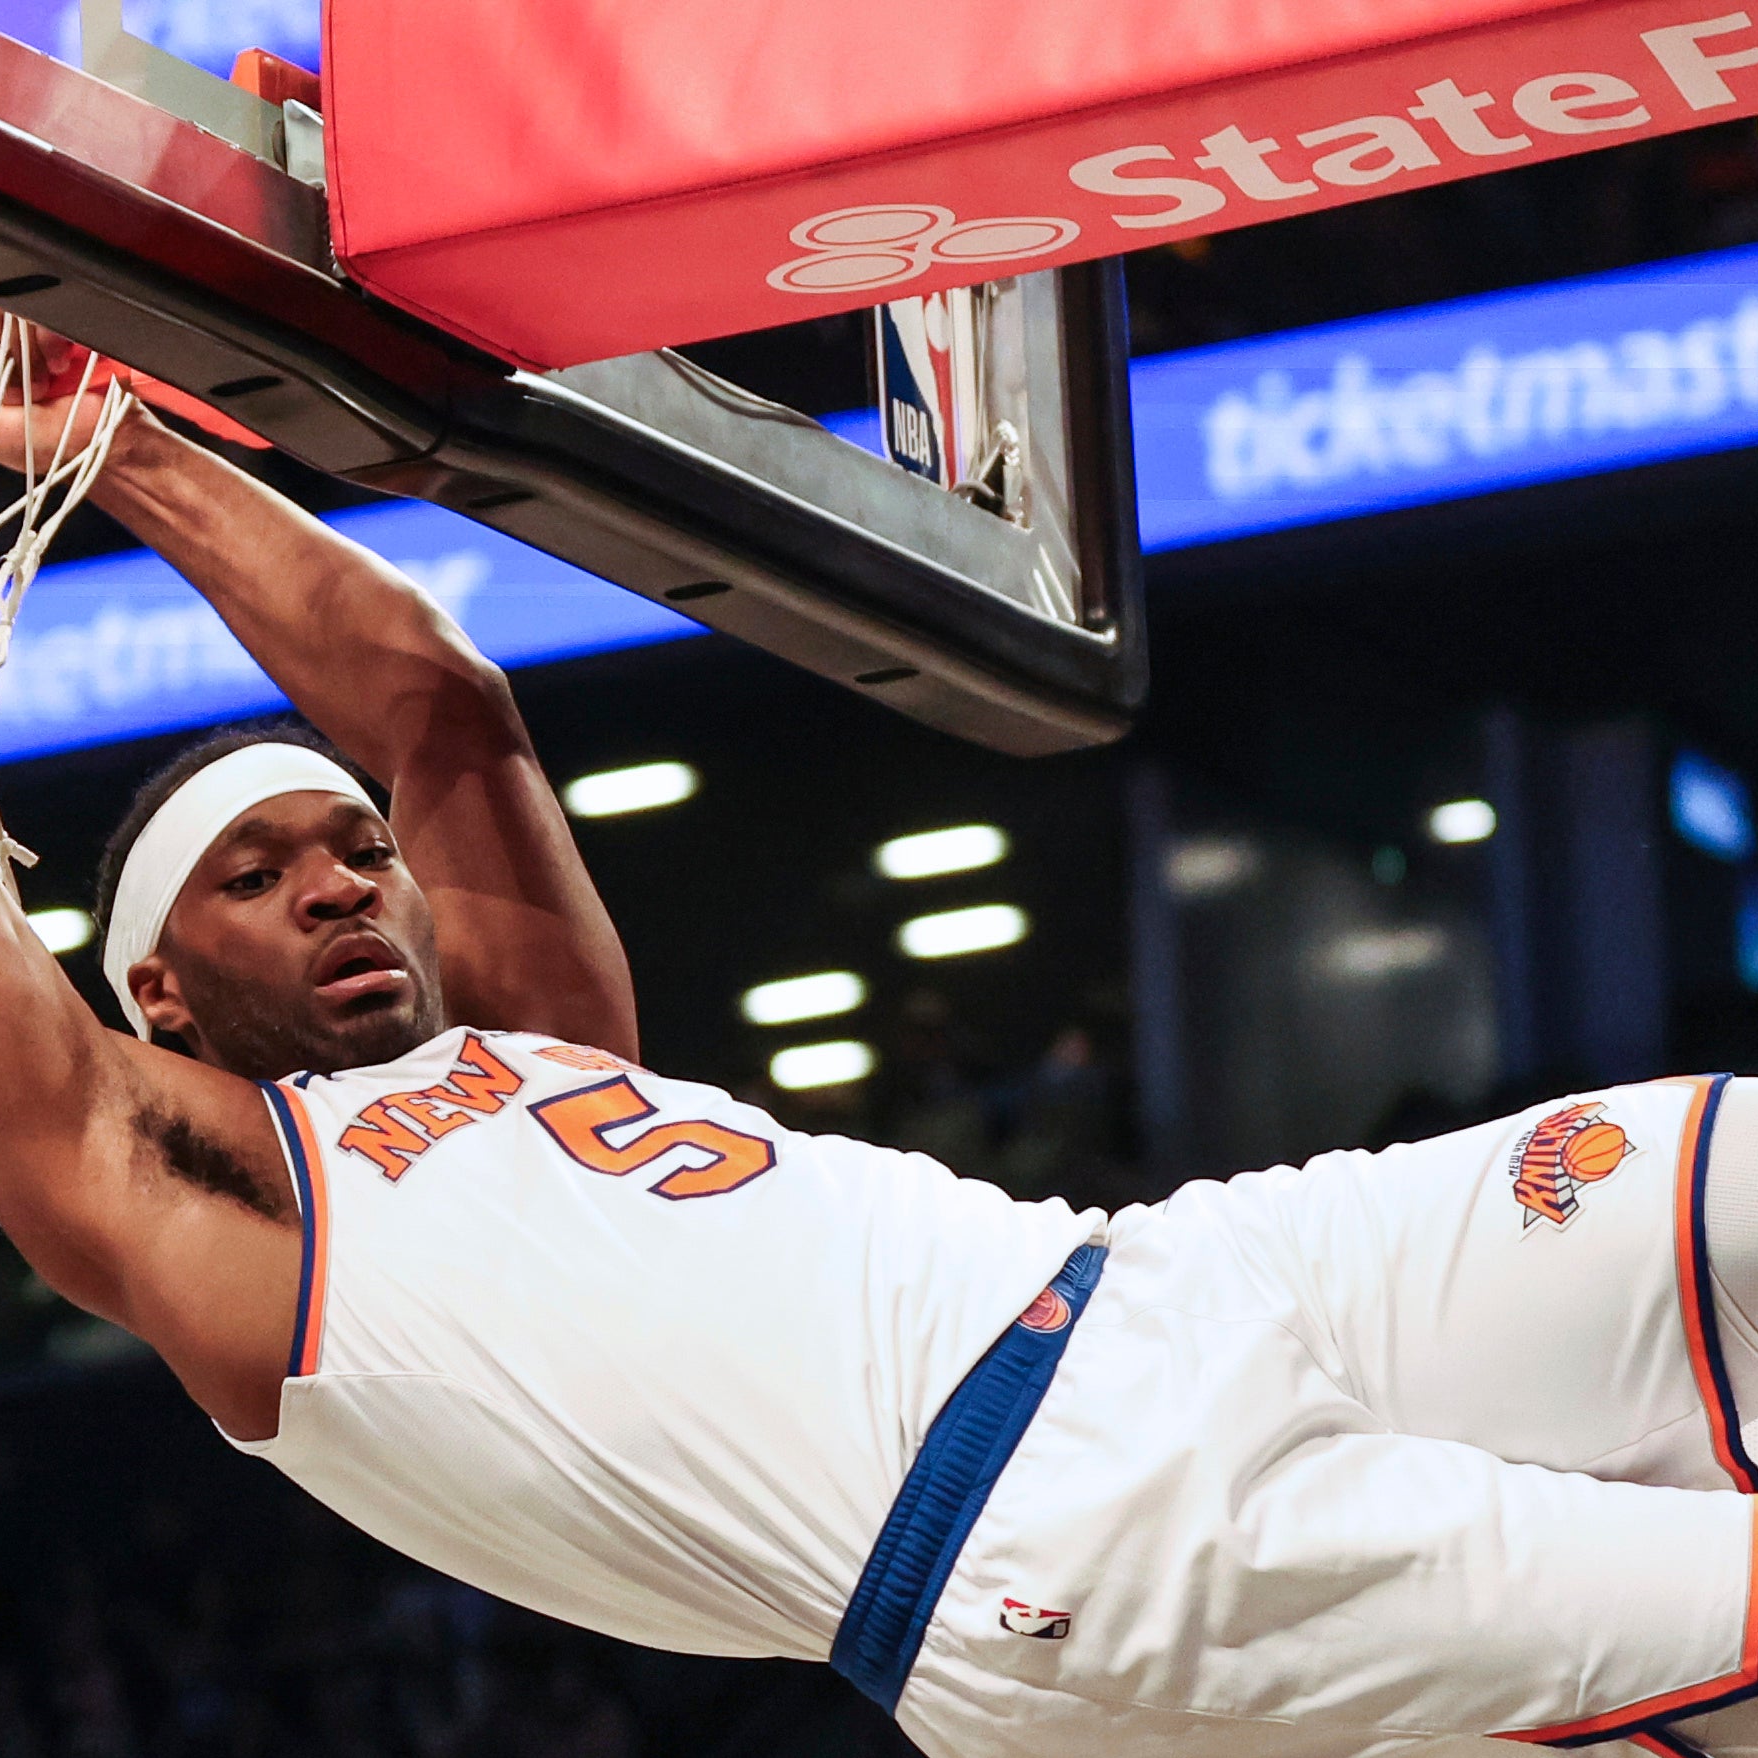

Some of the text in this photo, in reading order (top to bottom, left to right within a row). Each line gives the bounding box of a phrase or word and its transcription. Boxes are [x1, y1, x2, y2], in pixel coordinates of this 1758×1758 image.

[892, 397, 933, 469] NBA
[336, 1034, 526, 1186] NEW
[526, 1071, 778, 1201] 5
[1513, 1101, 1604, 1224] KNICKS
